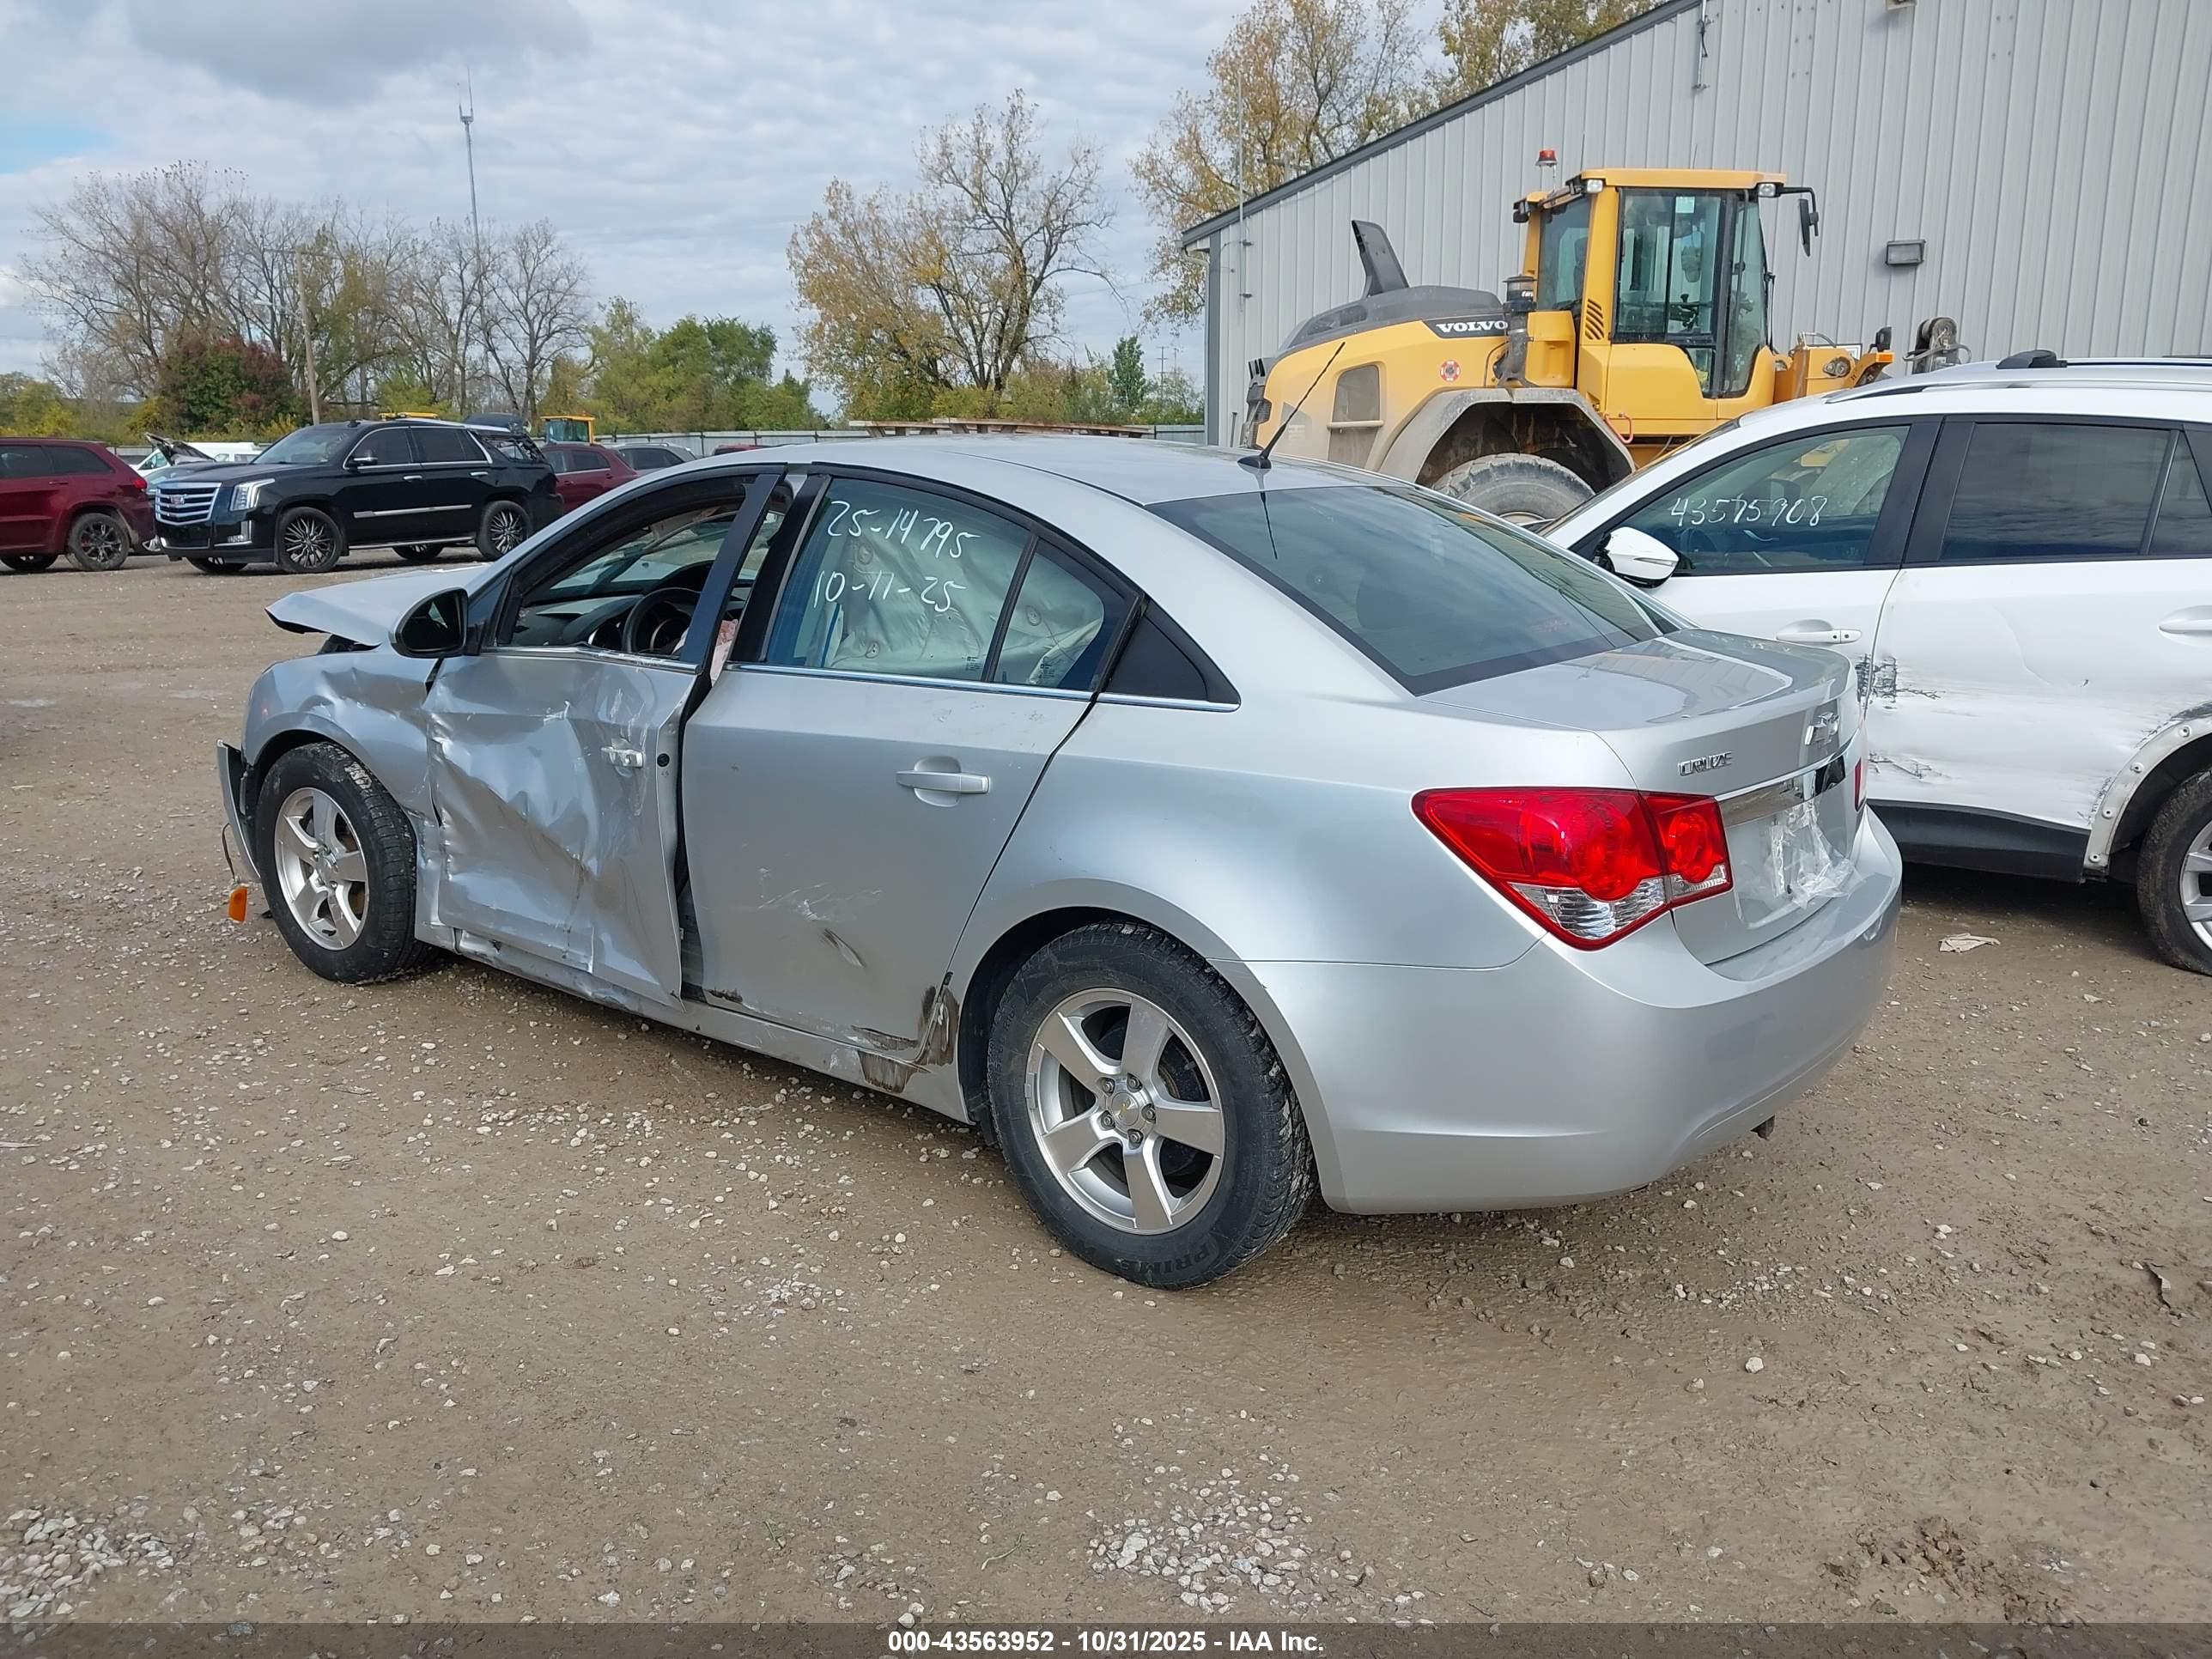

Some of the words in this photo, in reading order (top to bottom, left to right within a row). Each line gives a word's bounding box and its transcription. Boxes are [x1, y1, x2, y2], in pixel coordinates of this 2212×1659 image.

[1436, 320, 1509, 333] VOLVO
[1670, 494, 1827, 527] 43575908
[813, 569, 967, 613] 10-11-25
[1677, 750, 1732, 776] CRUZE
